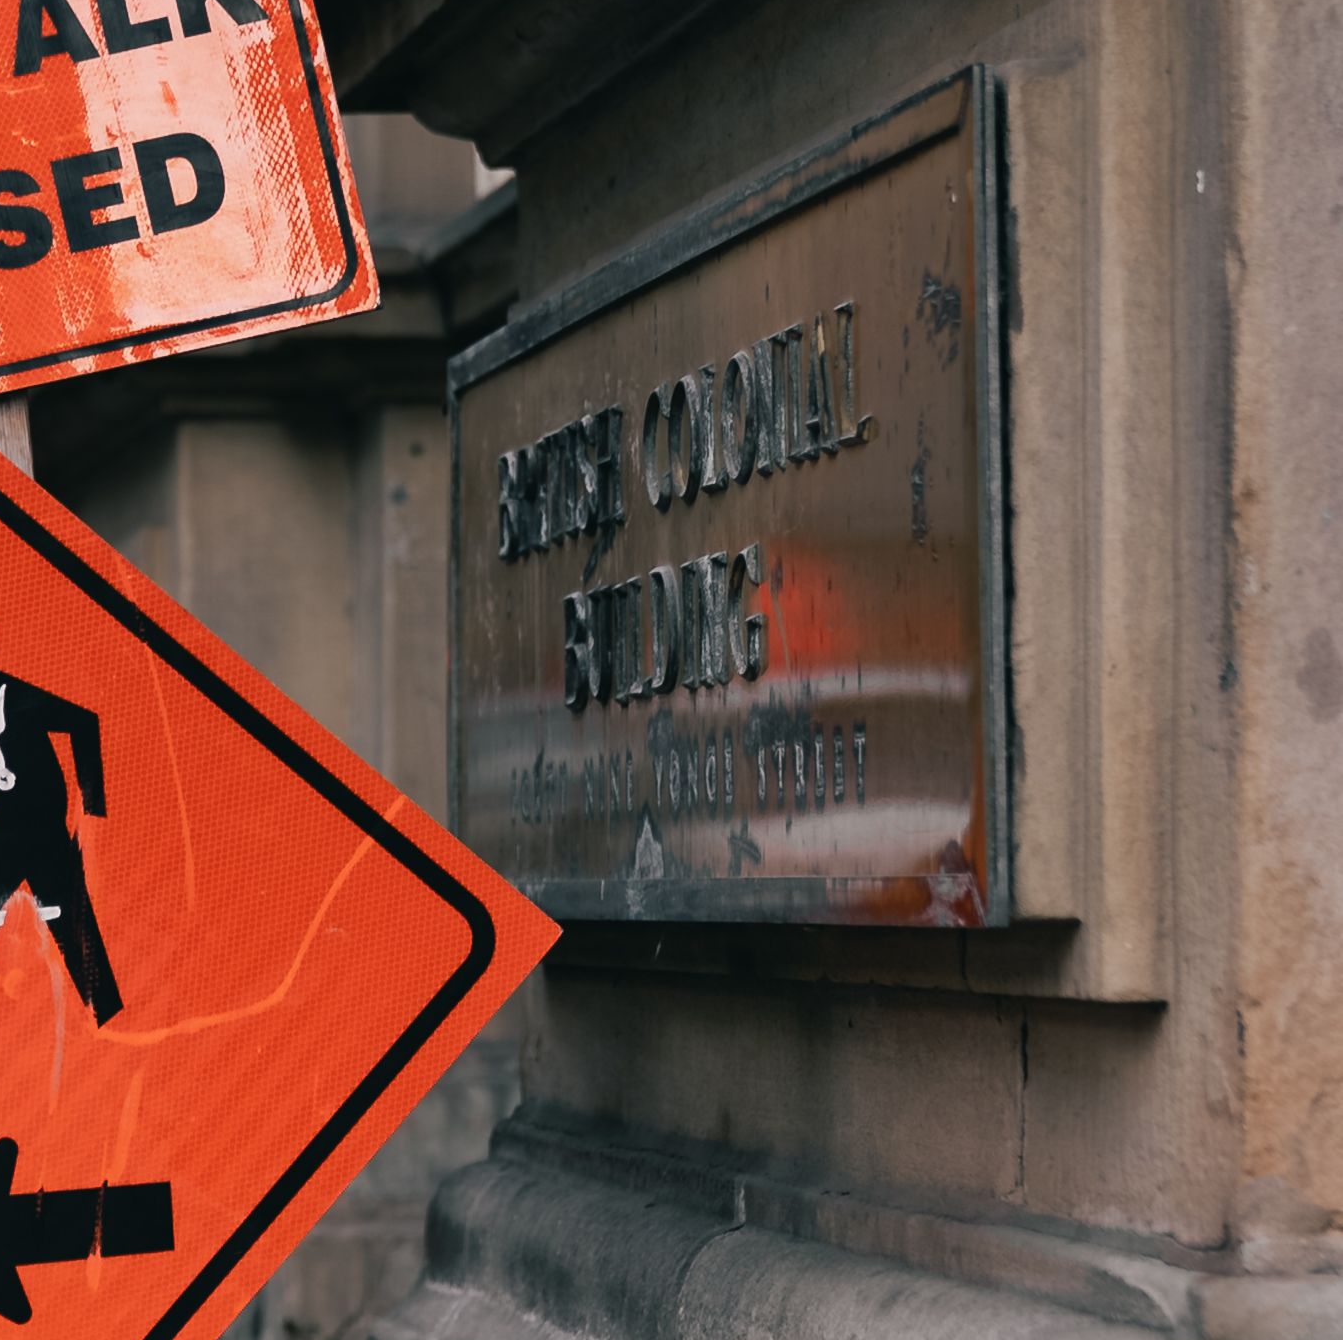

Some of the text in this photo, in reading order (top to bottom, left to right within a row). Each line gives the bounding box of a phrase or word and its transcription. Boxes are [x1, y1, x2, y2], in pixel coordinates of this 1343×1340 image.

[642, 301, 877, 514] COLONIAL
[563, 542, 769, 713] BUILDING
[756, 725, 867, 813] STREET
